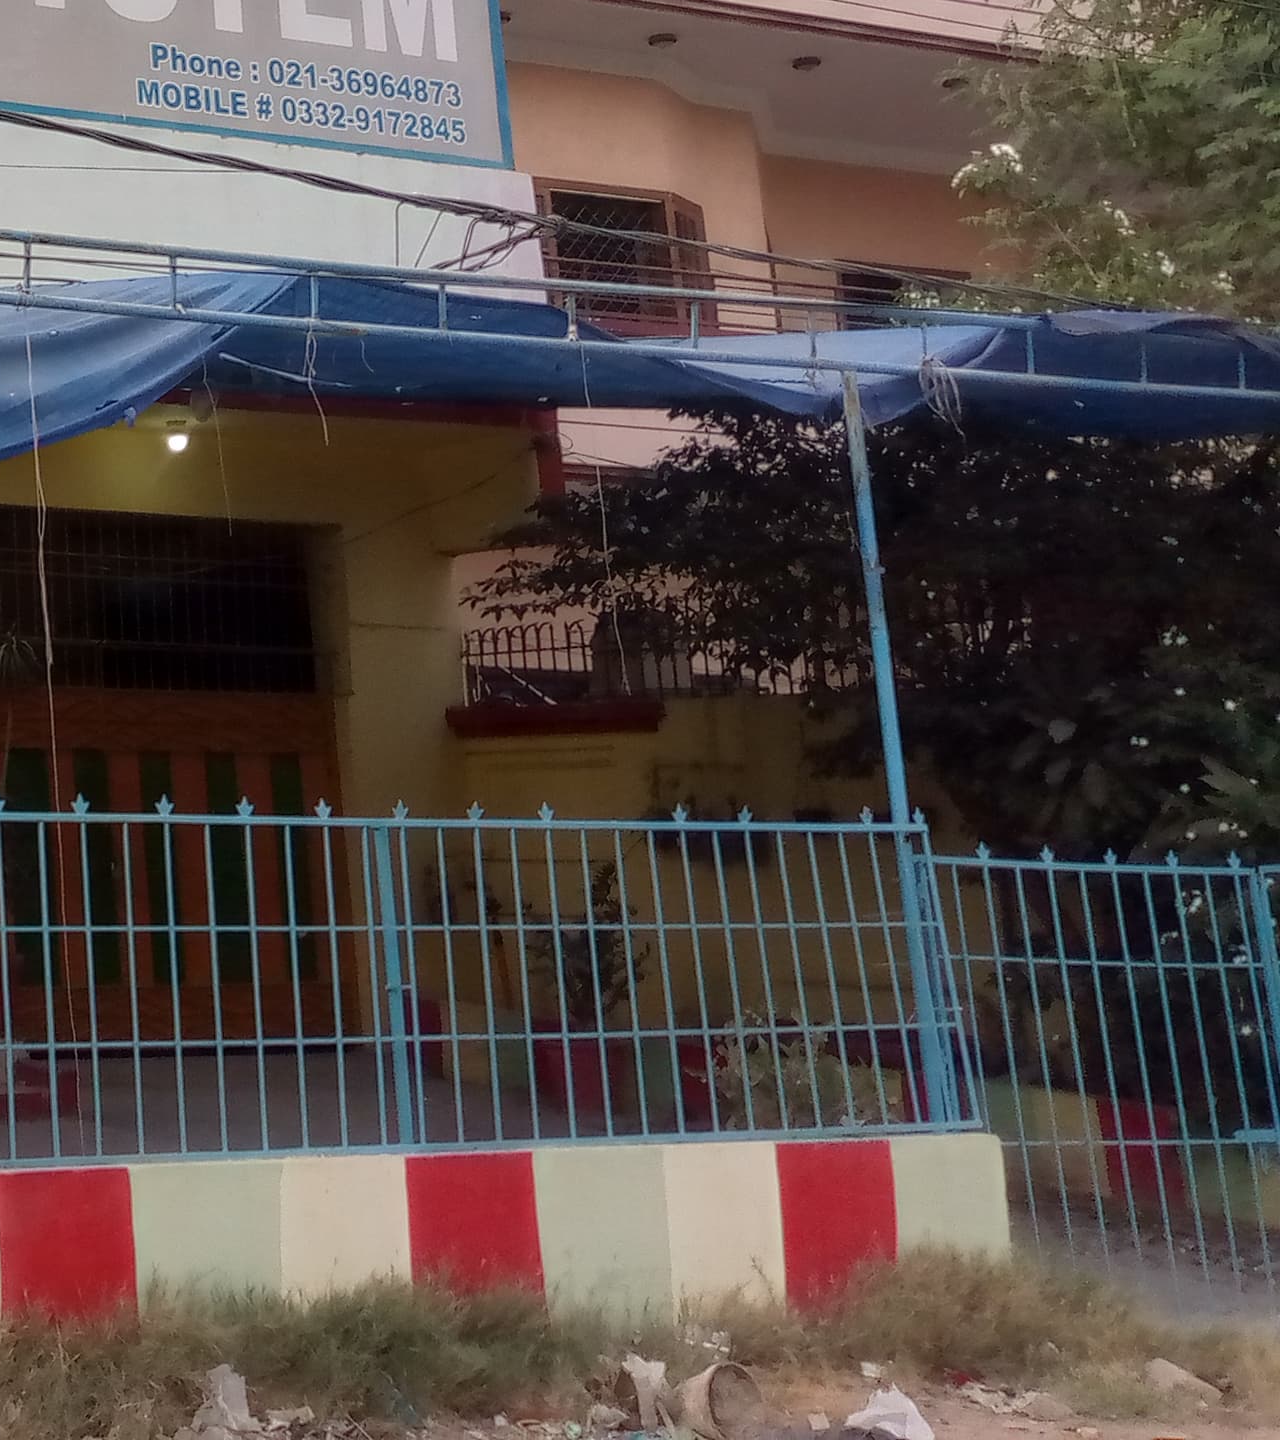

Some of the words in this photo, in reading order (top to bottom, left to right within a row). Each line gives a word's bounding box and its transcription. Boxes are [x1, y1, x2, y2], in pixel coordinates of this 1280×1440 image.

[149, 42, 243, 81] Phone
[267, 58, 464, 109] 021-36964873
[135, 78, 249, 120] MOBILE
[280, 97, 468, 145] 0332-9172845
